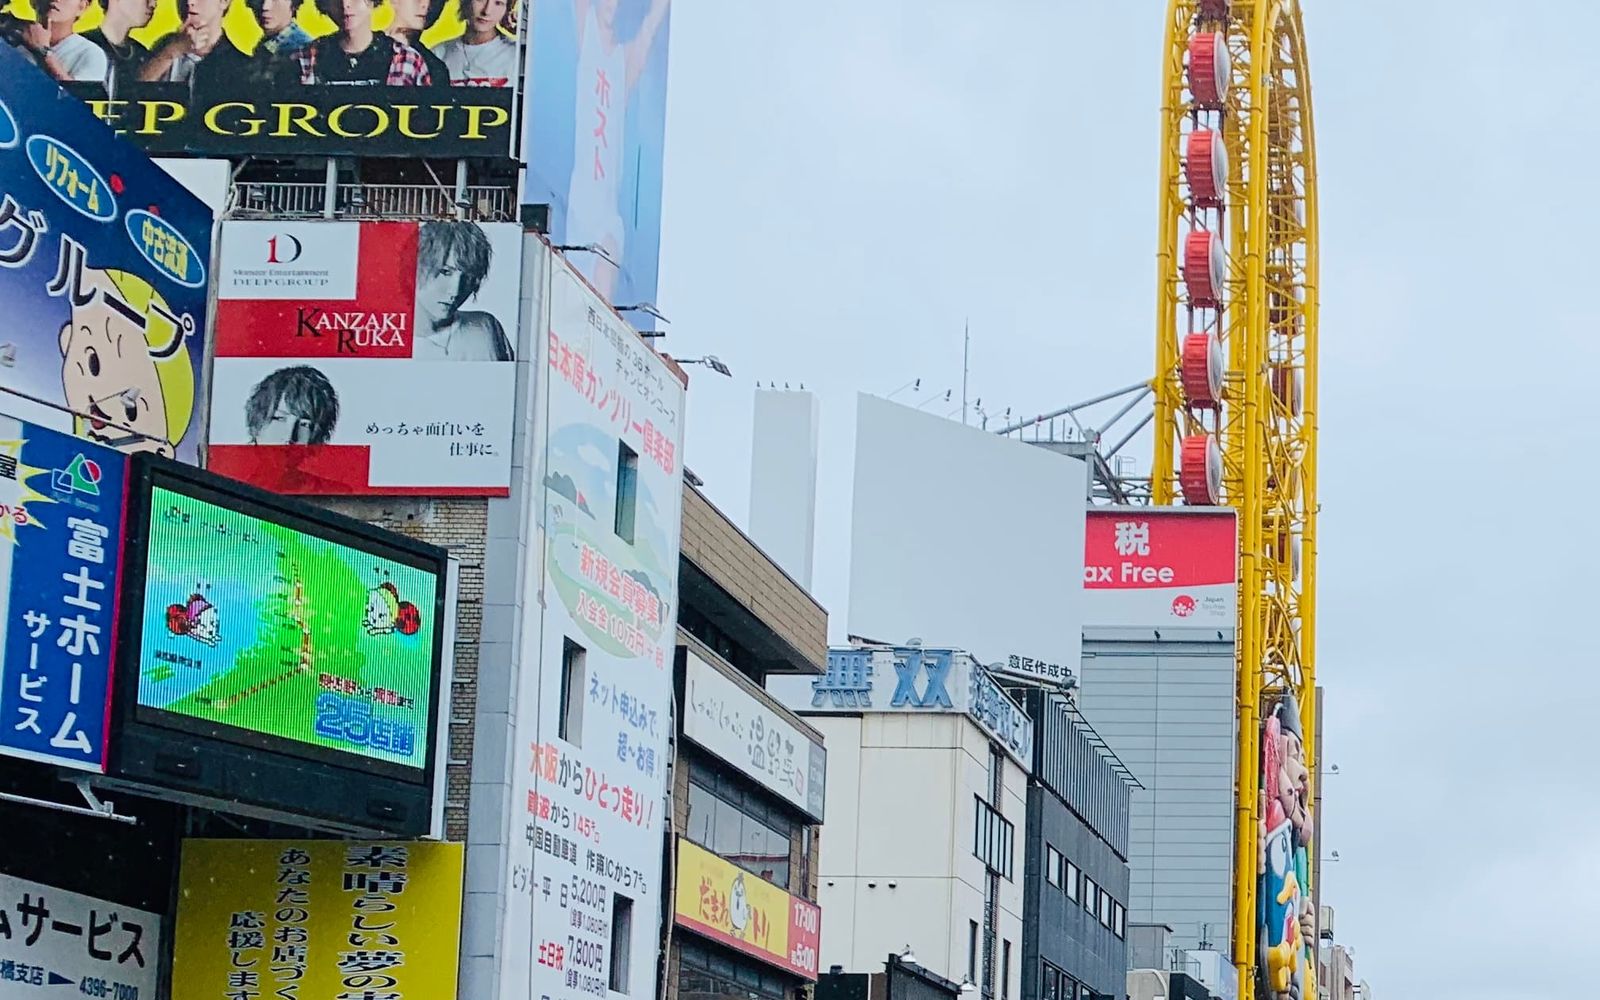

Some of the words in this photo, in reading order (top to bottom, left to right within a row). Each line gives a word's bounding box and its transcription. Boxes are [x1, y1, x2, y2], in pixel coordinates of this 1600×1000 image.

[204, 102, 508, 139] GROUP
[593, 66, 609, 181] ホスト
[44, 143, 99, 212] リフォーム
[141, 217, 190, 279] 中古流通
[296, 308, 408, 338] KANZAKI
[337, 328, 405, 354] RUKA
[365, 422, 485, 437] めっちゃ面白いを
[450, 442, 499, 456] 仕事に。
[1115, 522, 1150, 556] 税
[1121, 562, 1175, 583] Free
[50, 515, 109, 756] 富士ホーム
[15, 610, 52, 735] サービス
[1008, 653, 1072, 680] 意匠作成中
[530, 742, 653, 829] 大阪からひとつ走り!
[571, 874, 606, 914] 5,200円
[794, 901, 817, 934] 17:00
[537, 938, 565, 972] 土日祝
[567, 934, 603, 974] 7,800円
